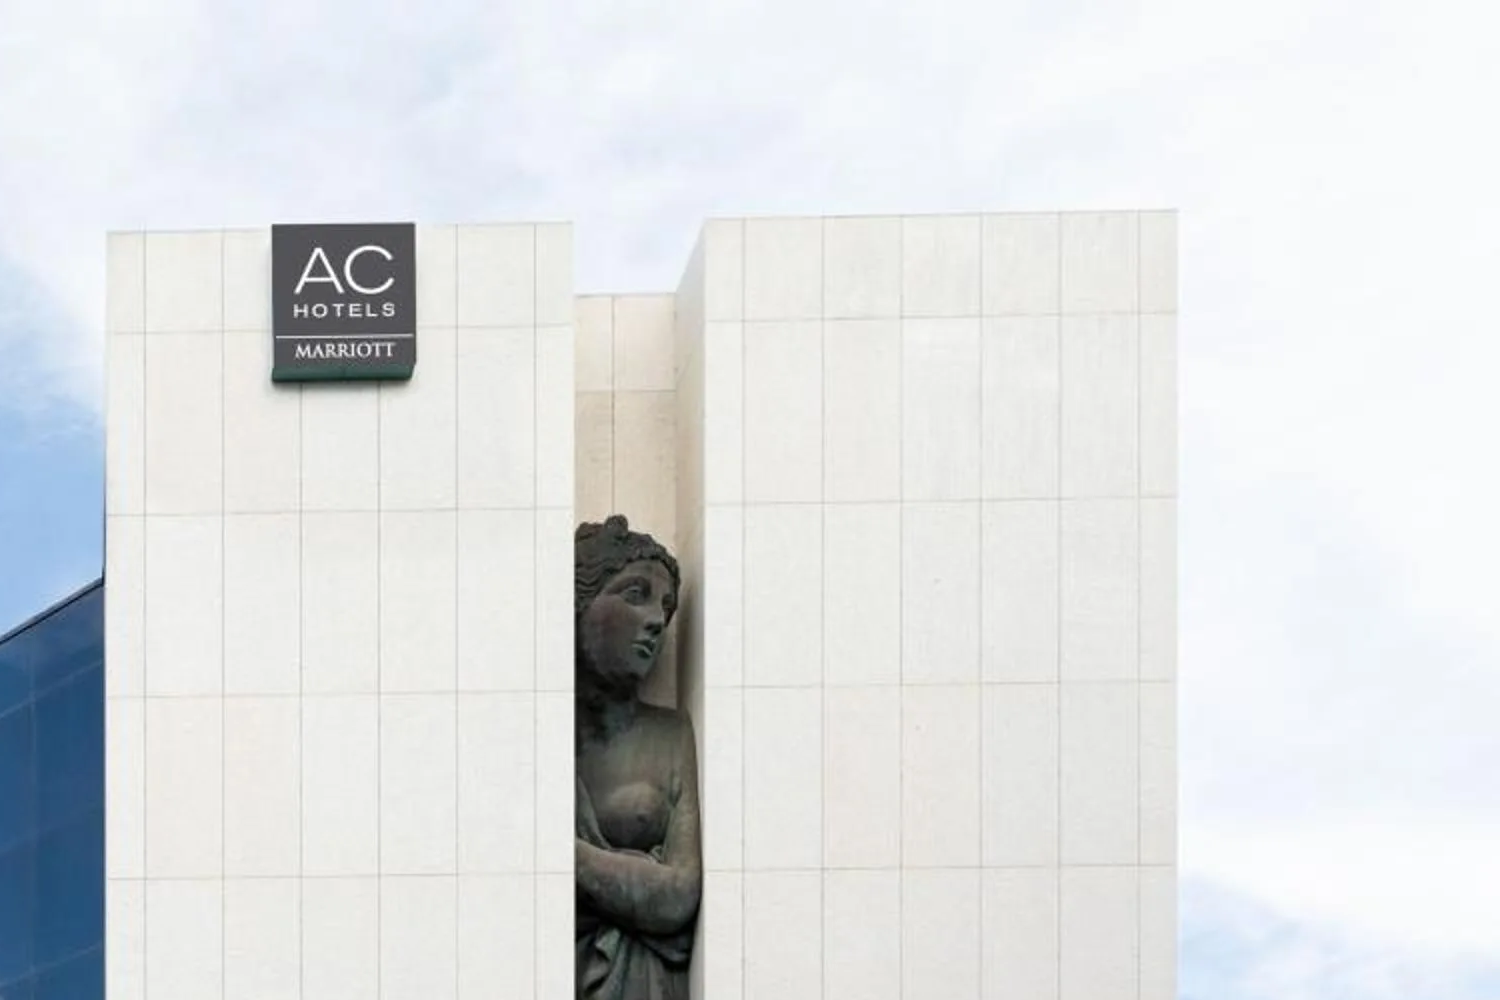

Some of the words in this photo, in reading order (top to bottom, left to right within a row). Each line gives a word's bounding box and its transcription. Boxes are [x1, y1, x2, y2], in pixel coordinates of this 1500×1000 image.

[294, 245, 395, 295] AC
[293, 302, 396, 318] HOTELS
[295, 341, 396, 359] MARRIOTT
